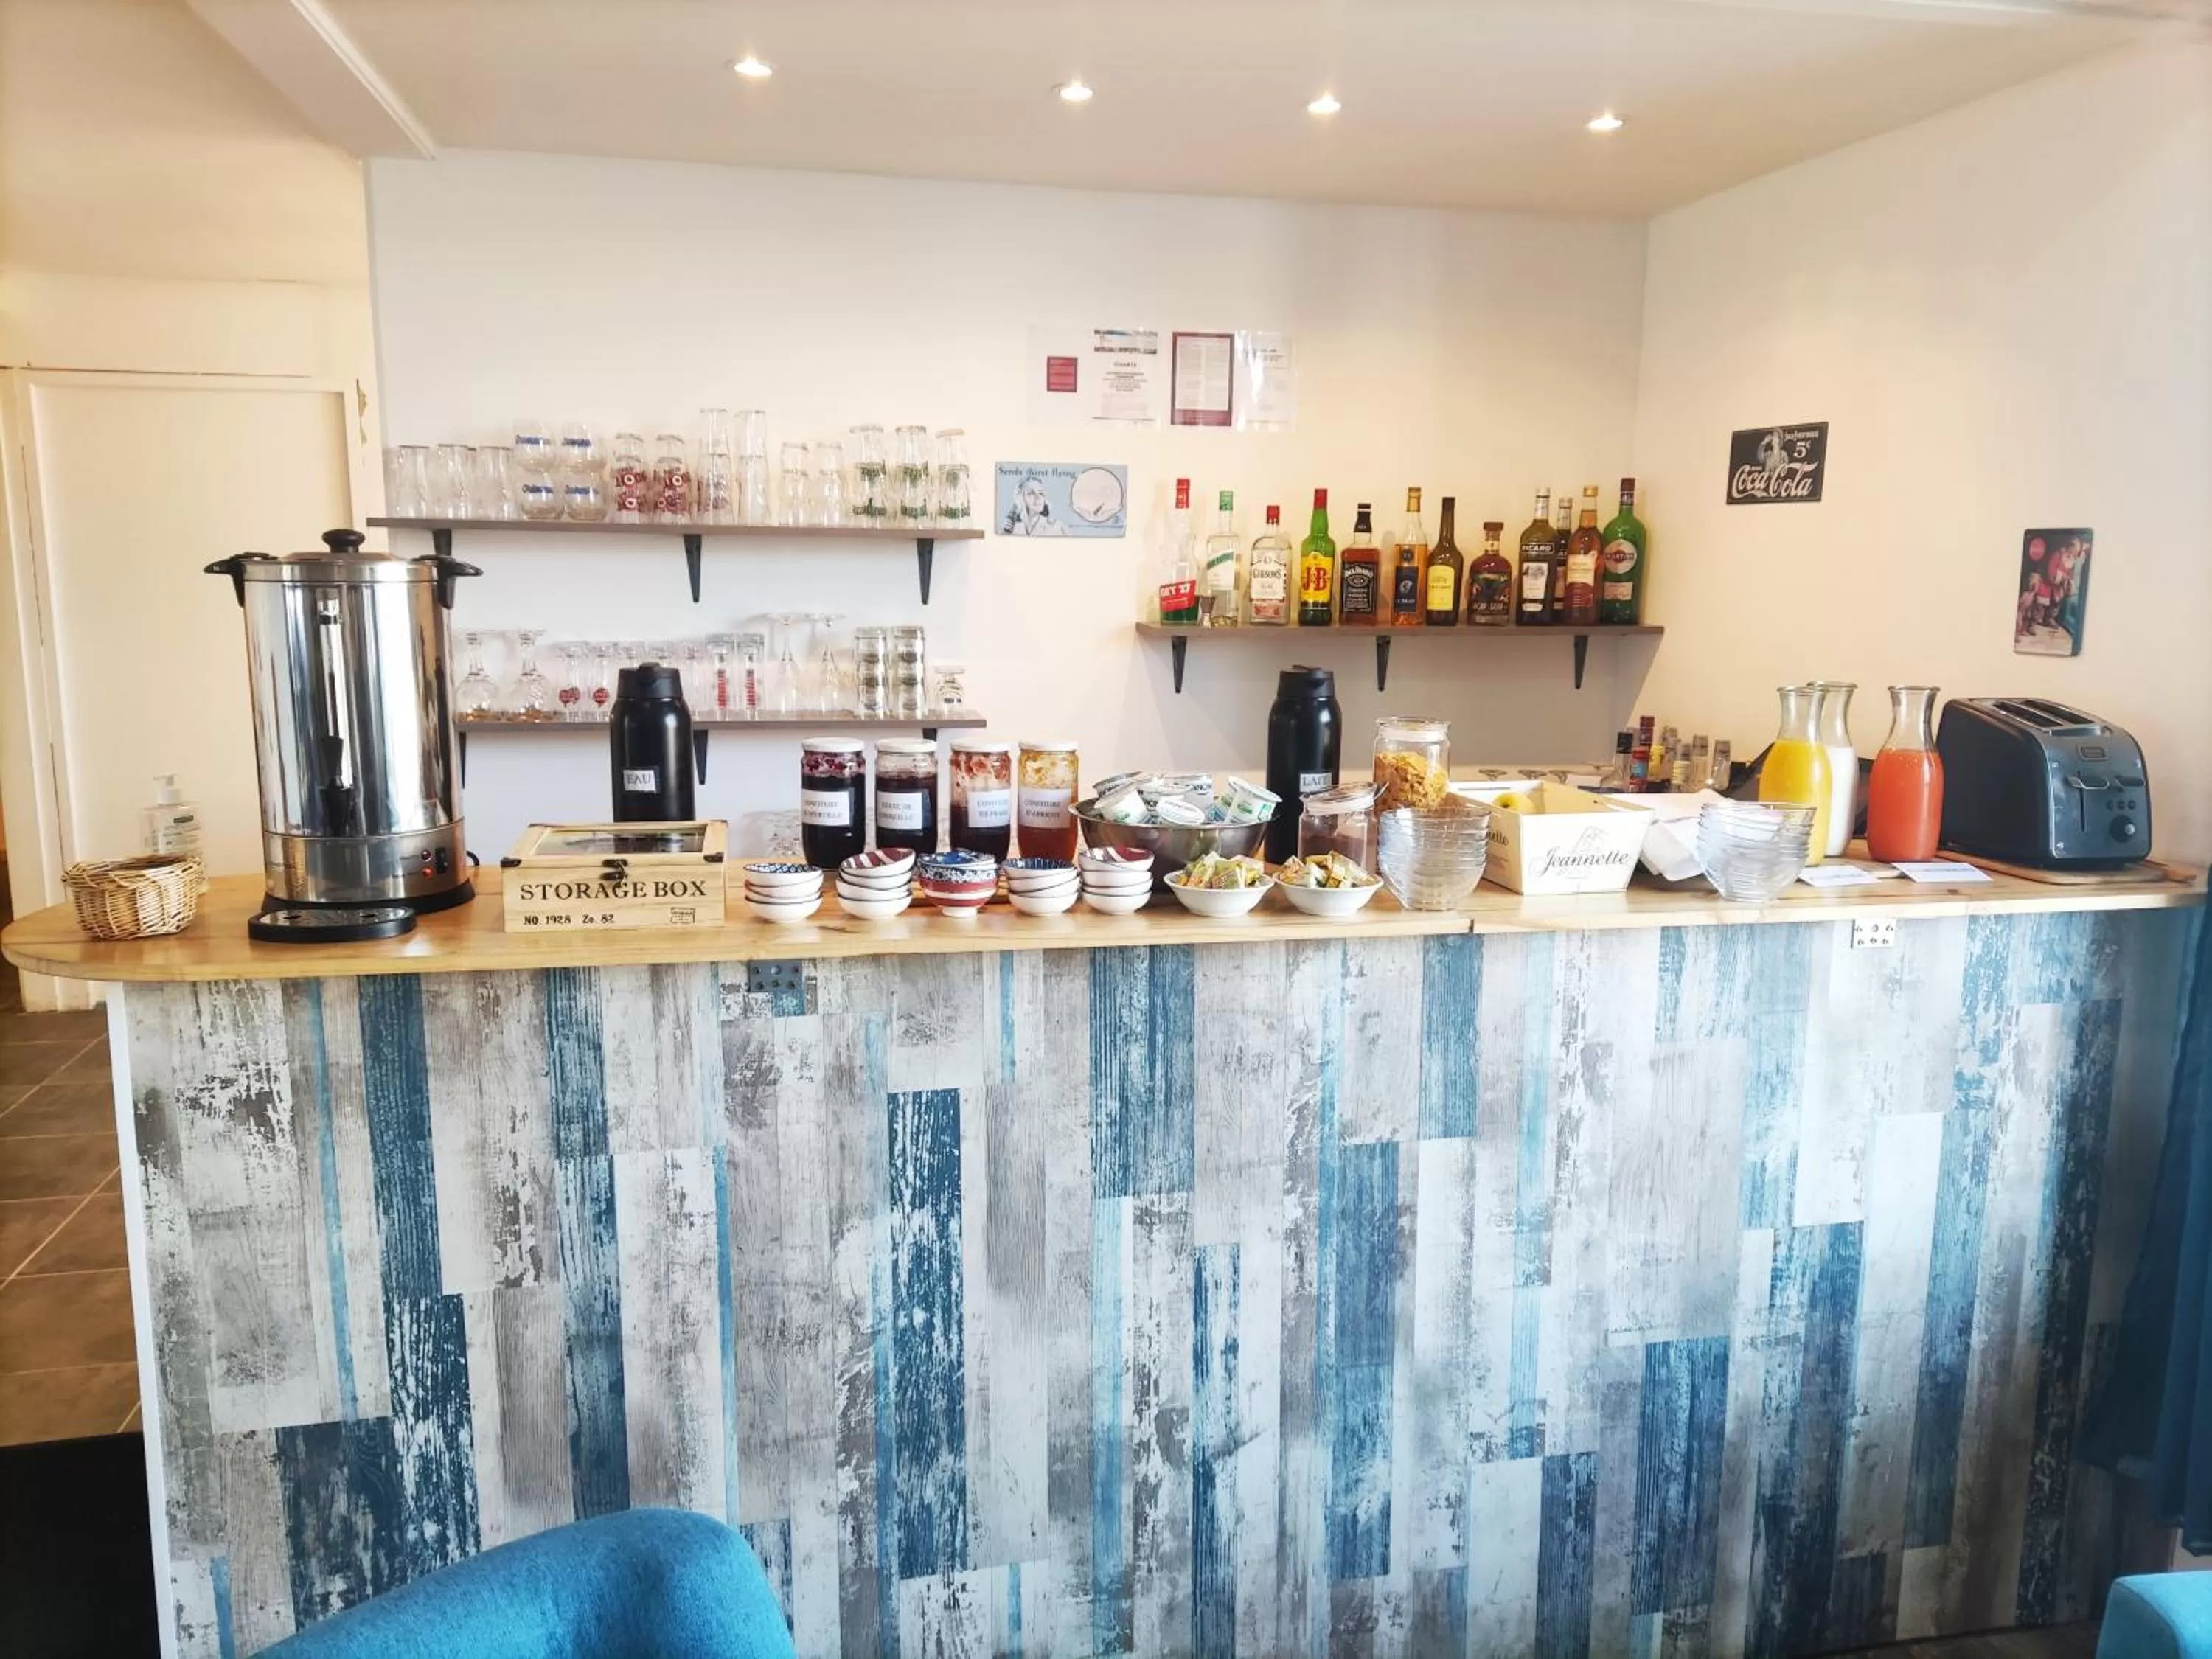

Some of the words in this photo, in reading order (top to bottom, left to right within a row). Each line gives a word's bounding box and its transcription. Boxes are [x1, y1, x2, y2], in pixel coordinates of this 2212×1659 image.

[625, 773, 652, 785] EAU
[520, 882, 647, 901] STORAGE
[653, 880, 707, 897] BOX
